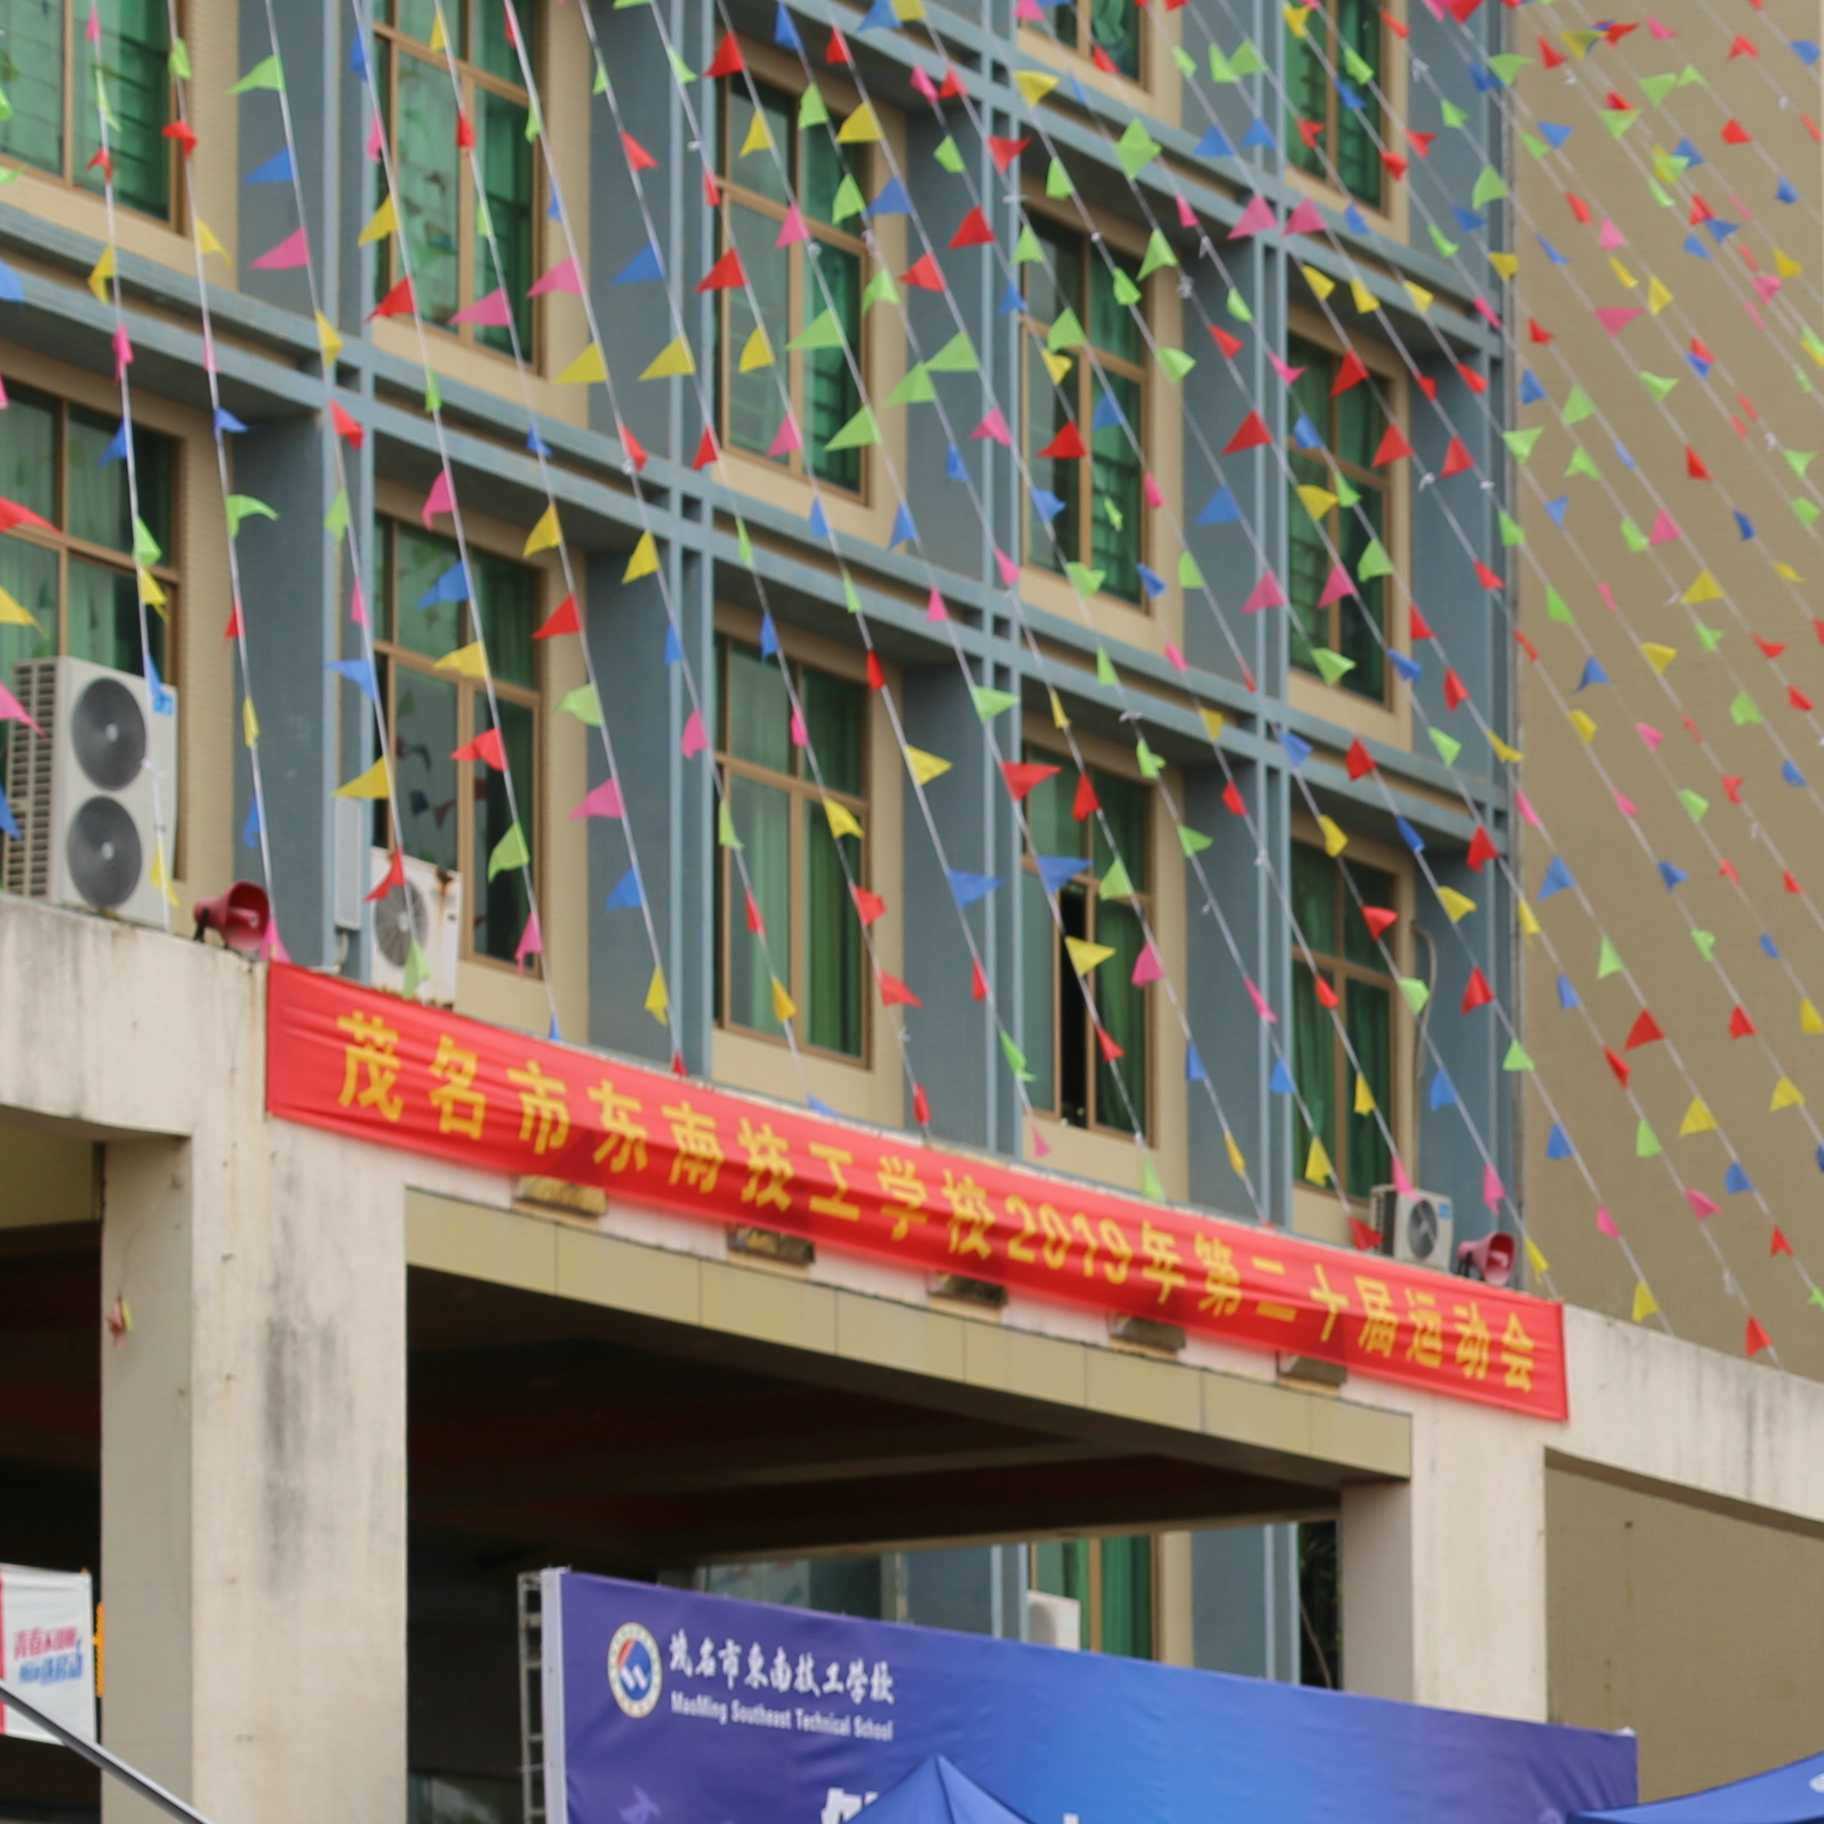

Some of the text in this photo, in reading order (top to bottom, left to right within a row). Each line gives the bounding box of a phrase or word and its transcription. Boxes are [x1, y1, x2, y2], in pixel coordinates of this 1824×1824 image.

[337, 1010, 1535, 1393] 茂名市东南技工学校2019年第二十届运动会
[731, 1699, 792, 1730] Southeast
[795, 1707, 851, 1737] Technical
[854, 1714, 894, 1742] School
